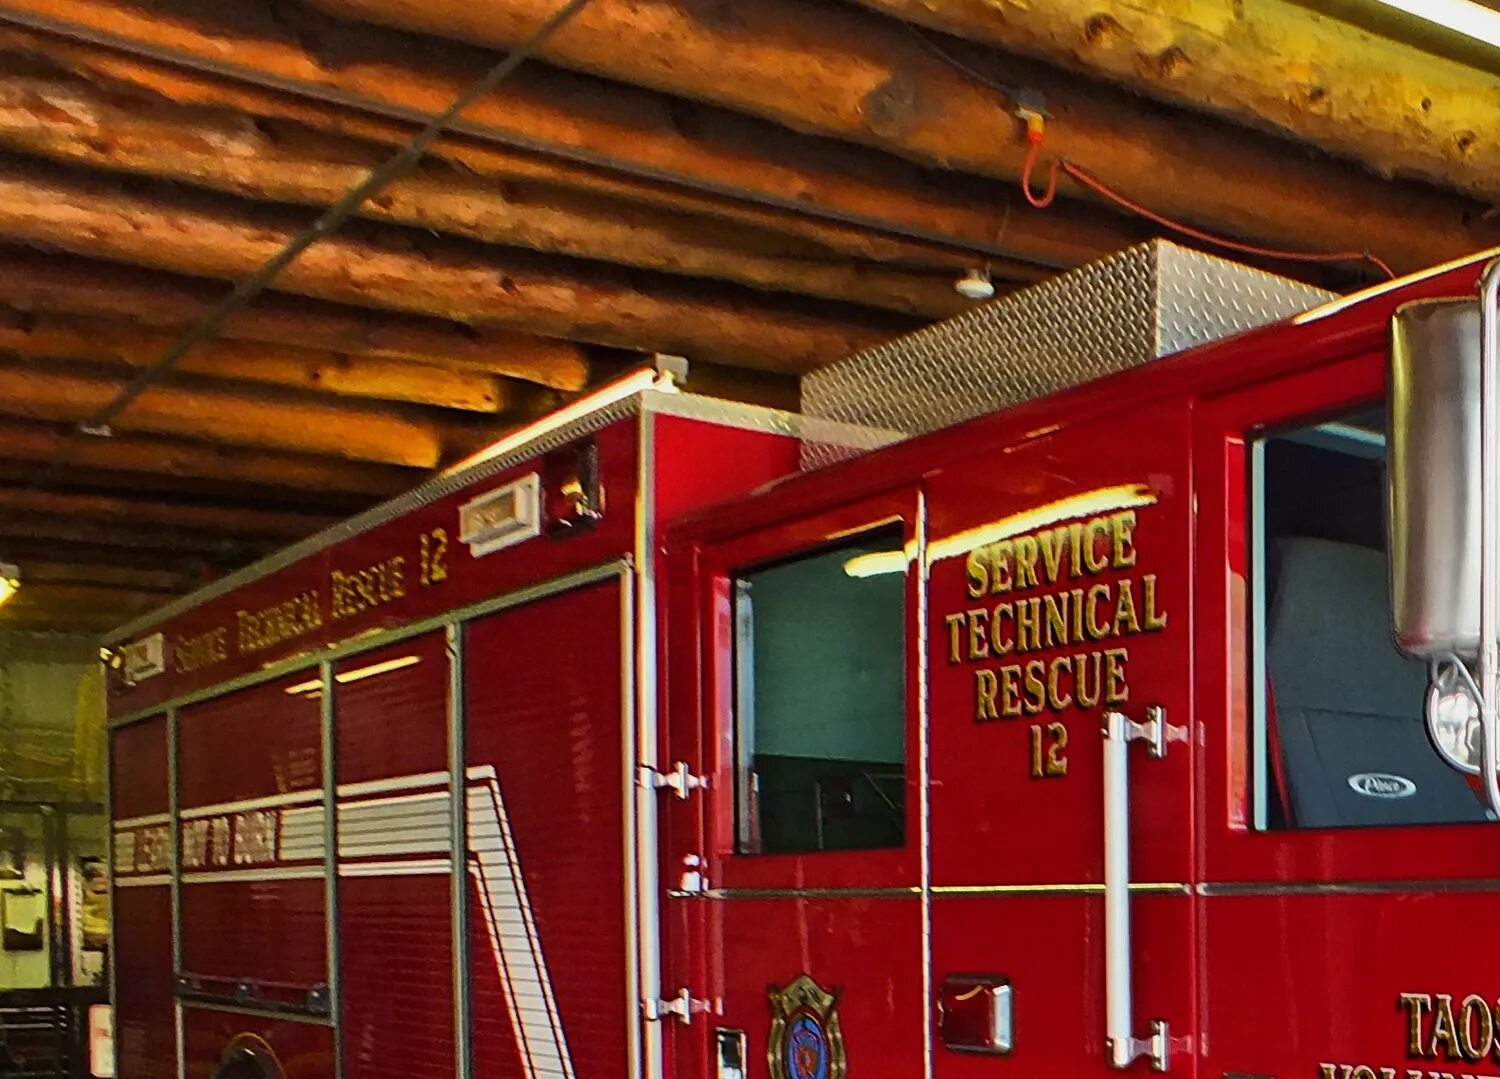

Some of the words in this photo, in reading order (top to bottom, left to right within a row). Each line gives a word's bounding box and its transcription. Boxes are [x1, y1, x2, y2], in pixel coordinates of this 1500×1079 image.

[419, 527, 449, 587] 12
[966, 511, 1137, 599] SERVICE
[945, 574, 1167, 664] TECHNICAL
[974, 648, 1131, 722] RESCUE
[1029, 721, 1069, 778] 12
